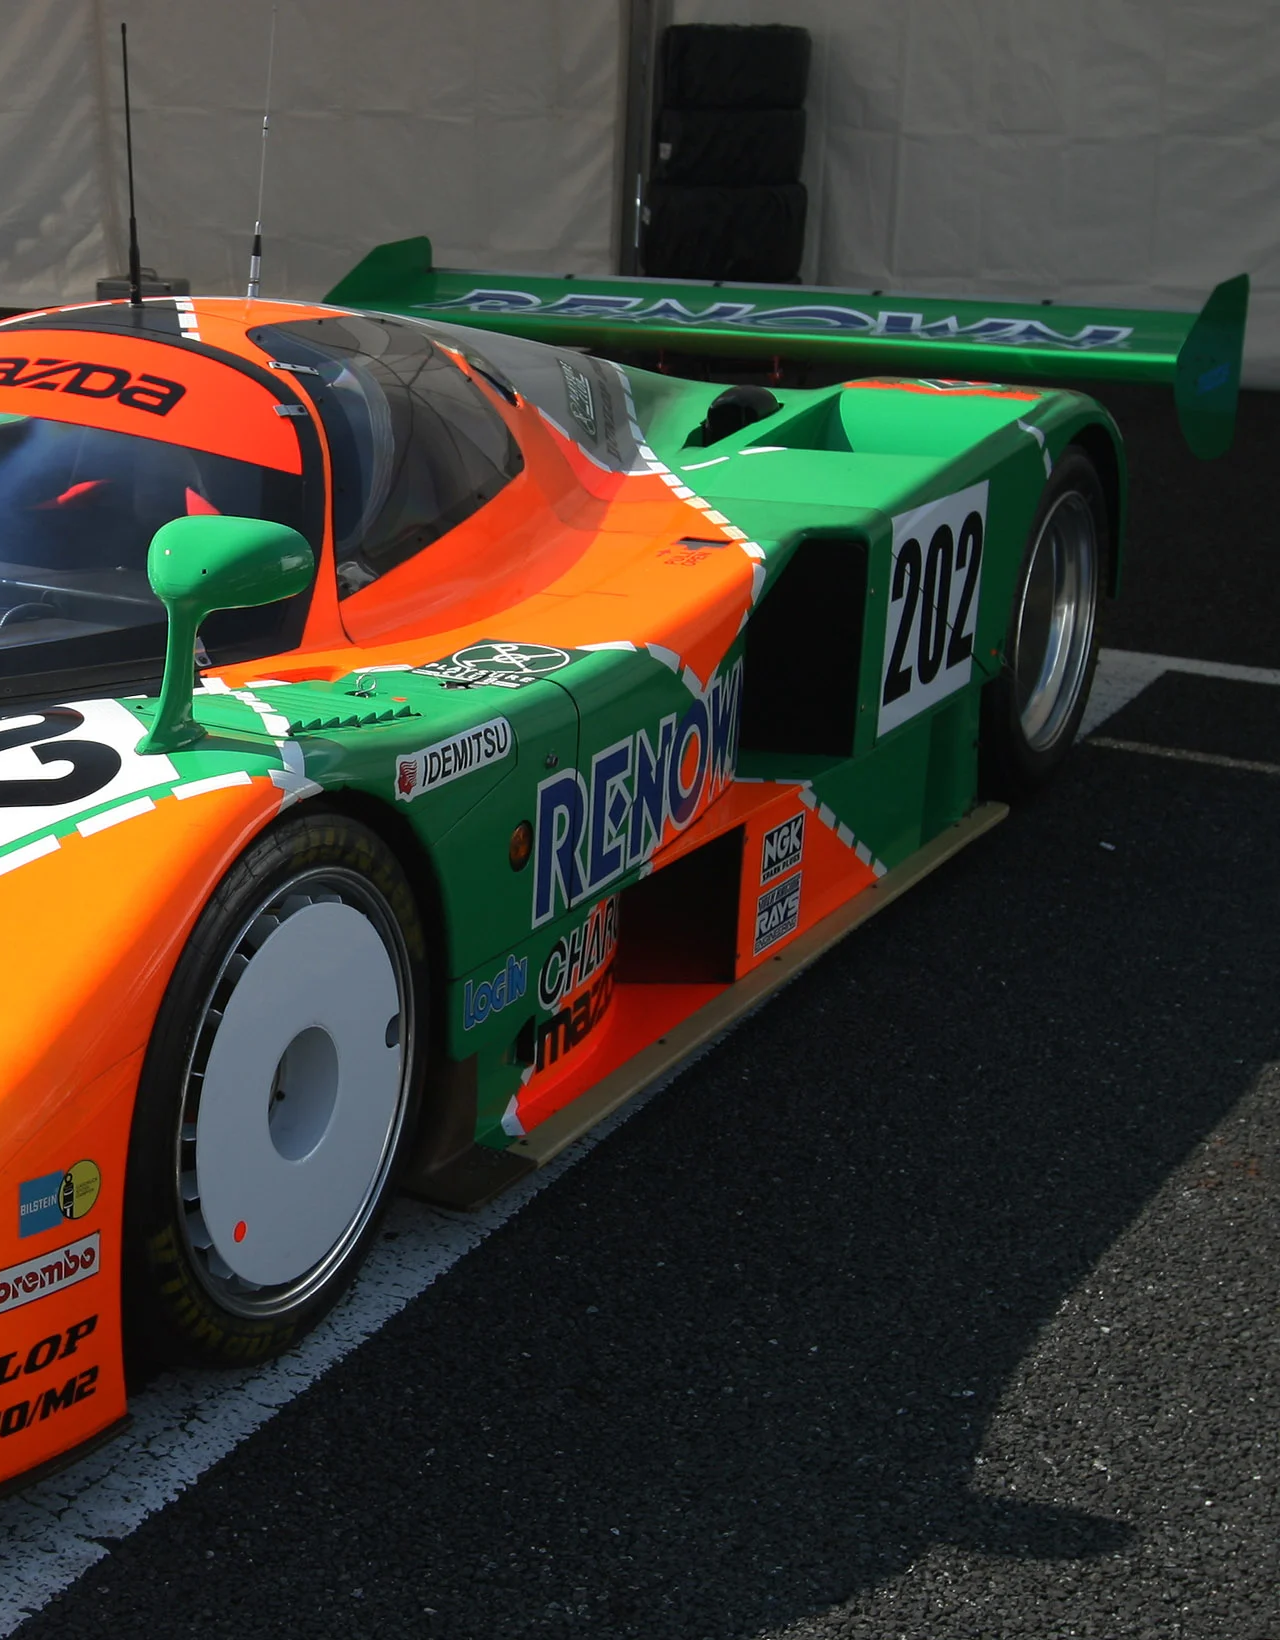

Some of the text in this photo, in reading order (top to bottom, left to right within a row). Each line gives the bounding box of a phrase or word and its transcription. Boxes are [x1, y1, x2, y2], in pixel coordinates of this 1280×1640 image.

[412, 289, 1133, 350] RENOWN
[884, 511, 984, 707] 202
[422, 722, 508, 786] IDEMITSU
[531, 655, 744, 929] RENOW
[764, 817, 802, 869] NGK
[782, 852, 801, 873] PLUGS
[756, 894, 799, 938] RAYS
[538, 892, 619, 1010] CHAR
[20, 1194, 58, 1216] BILSTEIN
